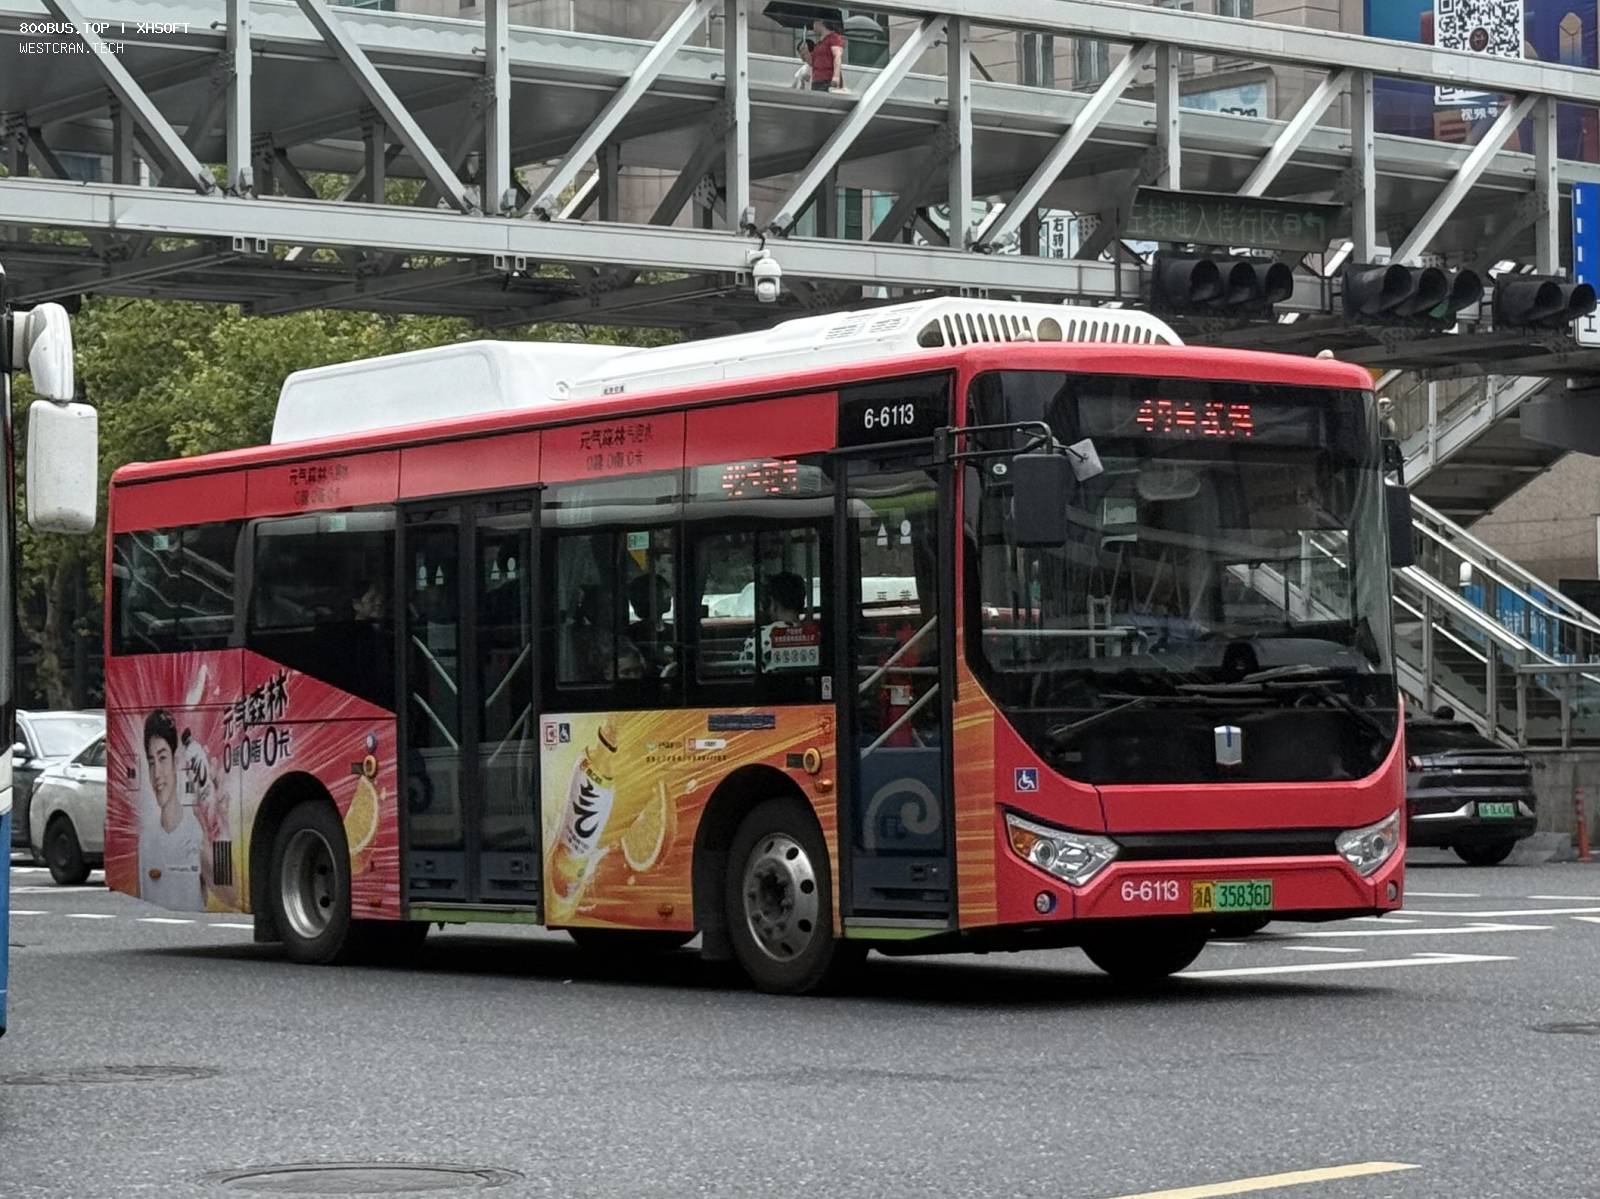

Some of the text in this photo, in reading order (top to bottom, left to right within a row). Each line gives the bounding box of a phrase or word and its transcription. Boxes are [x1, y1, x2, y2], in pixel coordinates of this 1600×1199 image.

[1460, 106, 1499, 121] 视频号
[1125, 201, 1281, 246] 左转进入待行区
[863, 403, 915, 429] 6-6113
[222, 668, 289, 741] 元气森林
[1121, 880, 1179, 901] 6-6113
